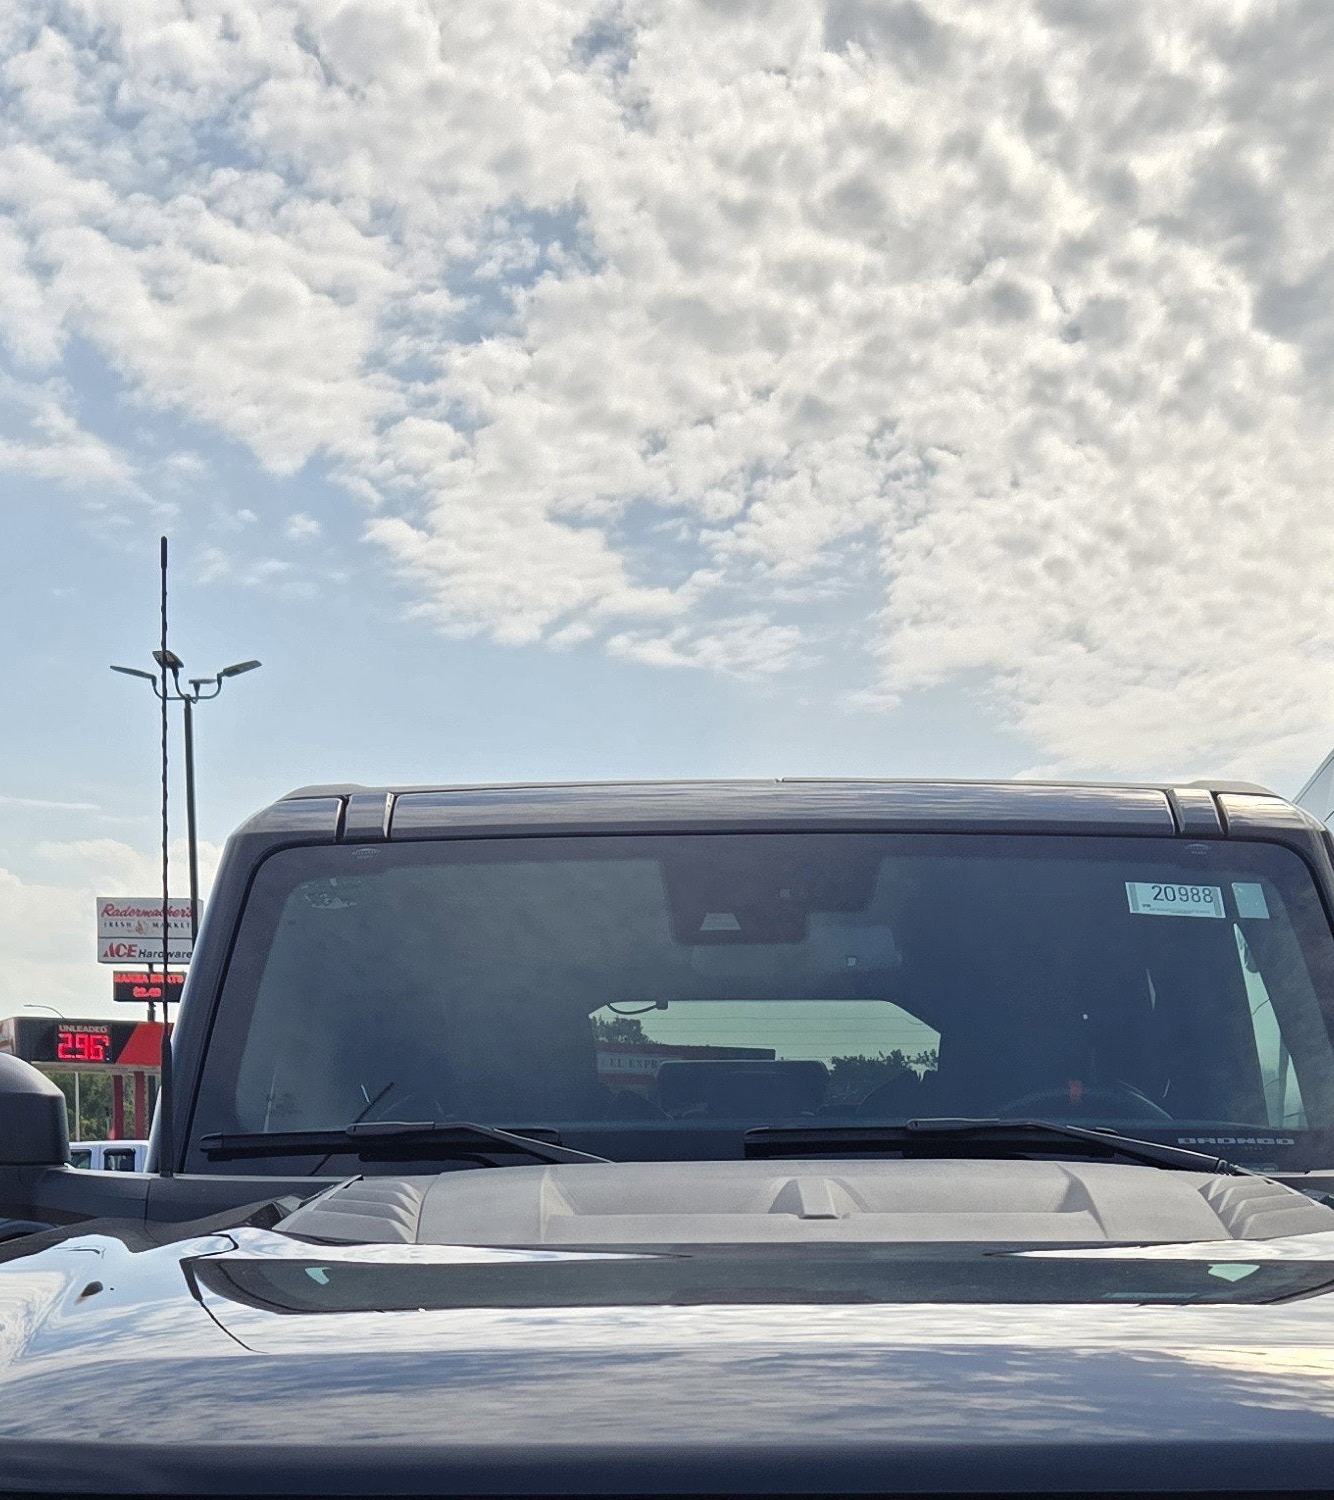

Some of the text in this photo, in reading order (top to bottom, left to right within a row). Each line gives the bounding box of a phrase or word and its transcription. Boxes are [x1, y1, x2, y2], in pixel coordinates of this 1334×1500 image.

[1151, 884, 1214, 903] 20988
[101, 903, 195, 918] Radermaher's
[103, 942, 138, 959] ACE
[58, 1024, 108, 1033] UNLEADED
